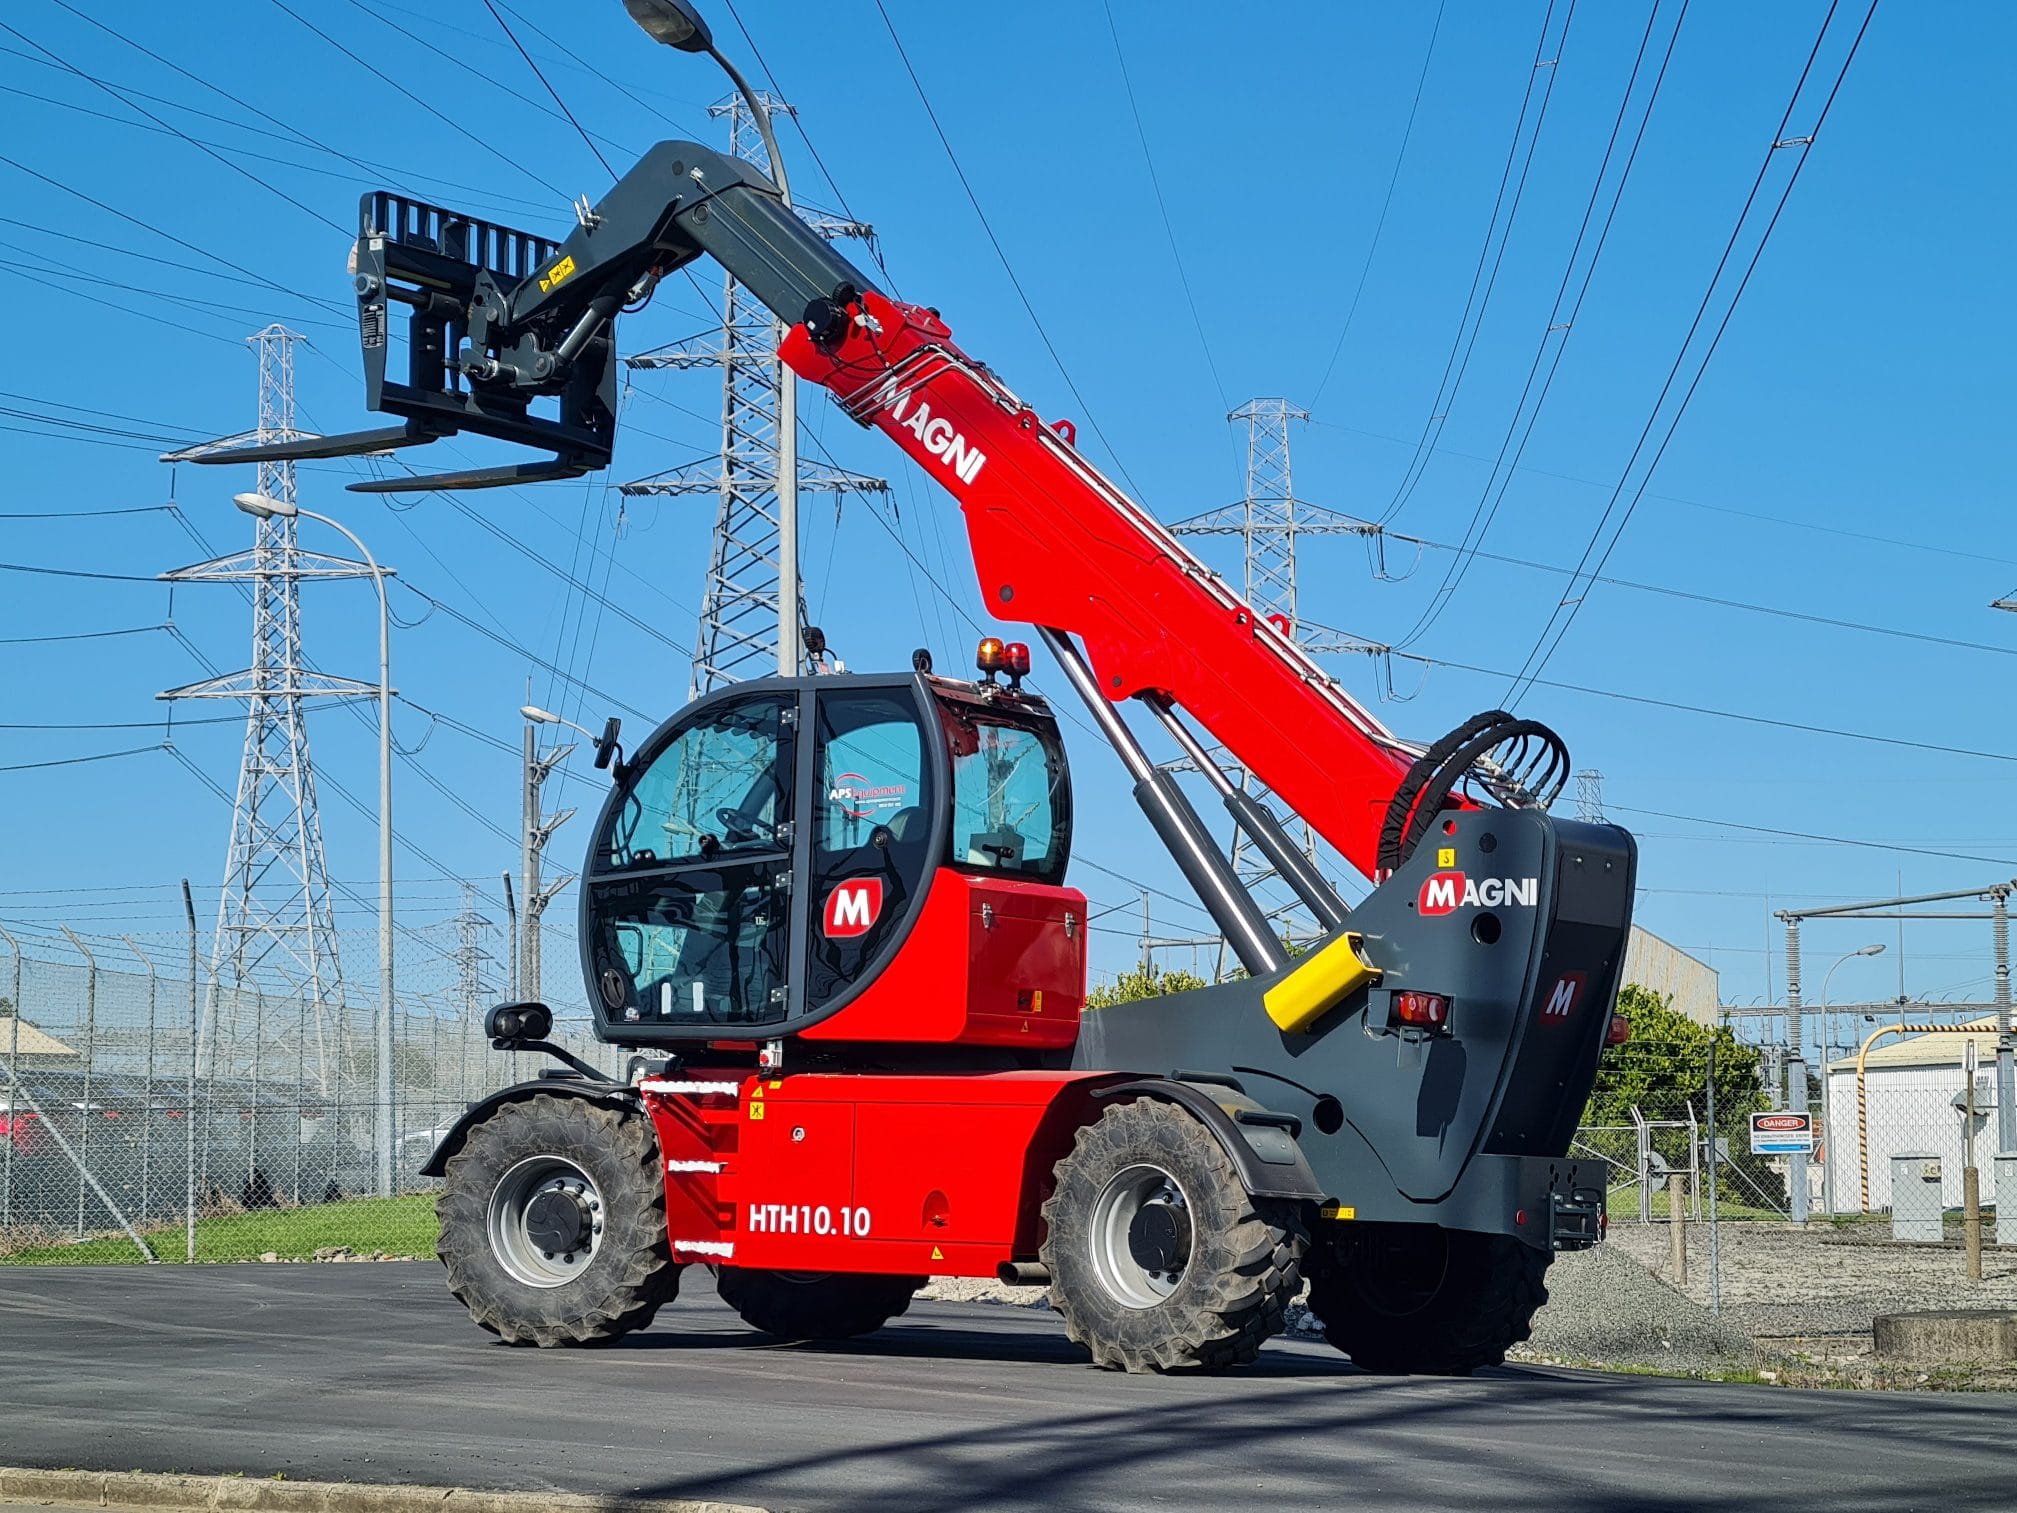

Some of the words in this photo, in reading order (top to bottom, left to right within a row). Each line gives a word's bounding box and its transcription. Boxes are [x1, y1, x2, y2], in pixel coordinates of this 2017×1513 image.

[873, 375, 986, 485] MAGNI
[833, 888, 870, 926] M
[1426, 878, 1538, 907] MAGNI
[1546, 979, 1576, 1017] M
[1763, 1119, 1799, 1127] DANGER
[749, 1203, 871, 1237] HTH10.10
